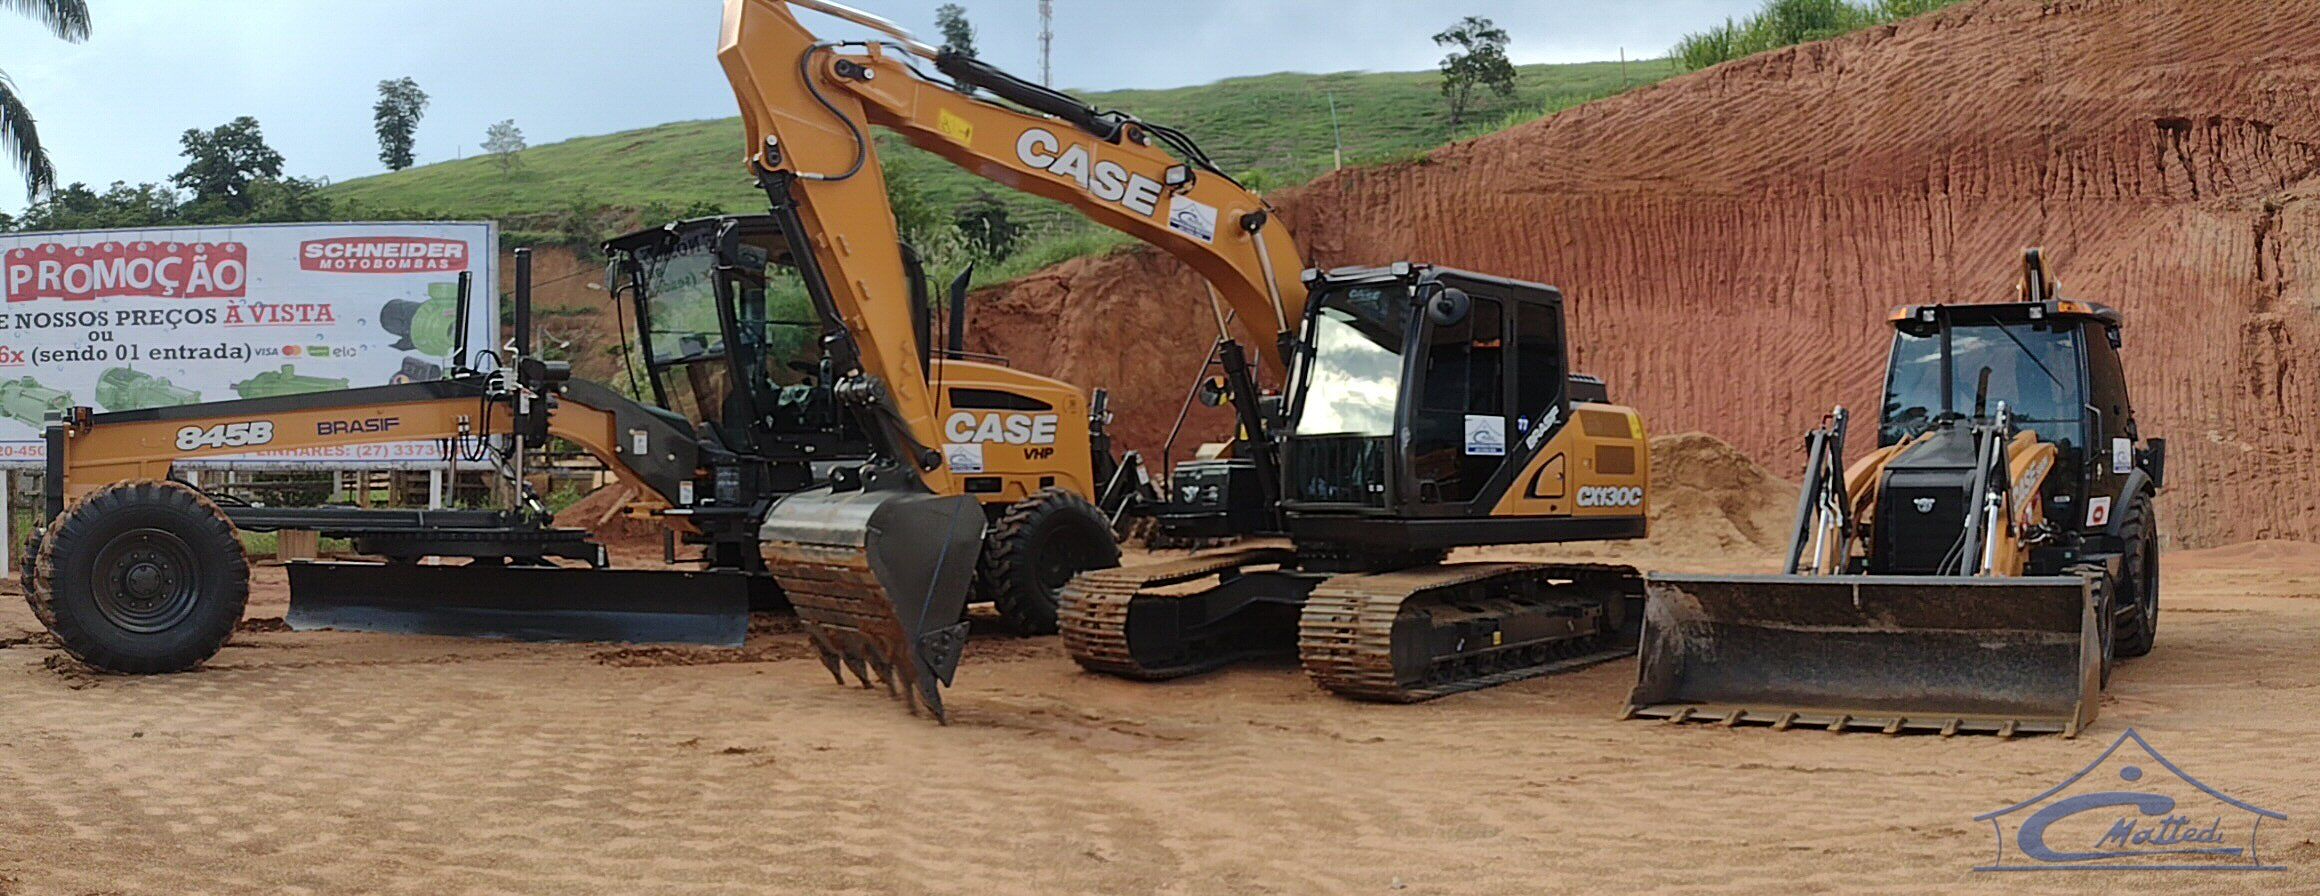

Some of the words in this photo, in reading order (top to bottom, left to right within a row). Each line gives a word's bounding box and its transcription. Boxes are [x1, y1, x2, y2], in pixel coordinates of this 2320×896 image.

[1017, 128, 1163, 216] CASE
[305, 243, 464, 258] SCHNEIDER
[320, 258, 449, 269] MOTOBOMBAS
[10, 254, 245, 296] PROMOÇÃO
[15, 311, 108, 330] NOSSOS
[115, 308, 217, 329] PREÇOS
[225, 300, 244, 324] À
[249, 303, 336, 323] VISTA
[88, 331, 114, 342] ou
[32, 344, 108, 366] (sendo
[115, 344, 140, 360] 01
[149, 343, 252, 363] entrada)
[255, 345, 278, 356] VISA
[176, 421, 274, 450] 845B
[317, 417, 400, 436] BRASIF
[944, 412, 1059, 445] CASE
[356, 444, 388, 457] (27)
[1024, 447, 1054, 460] VHP
